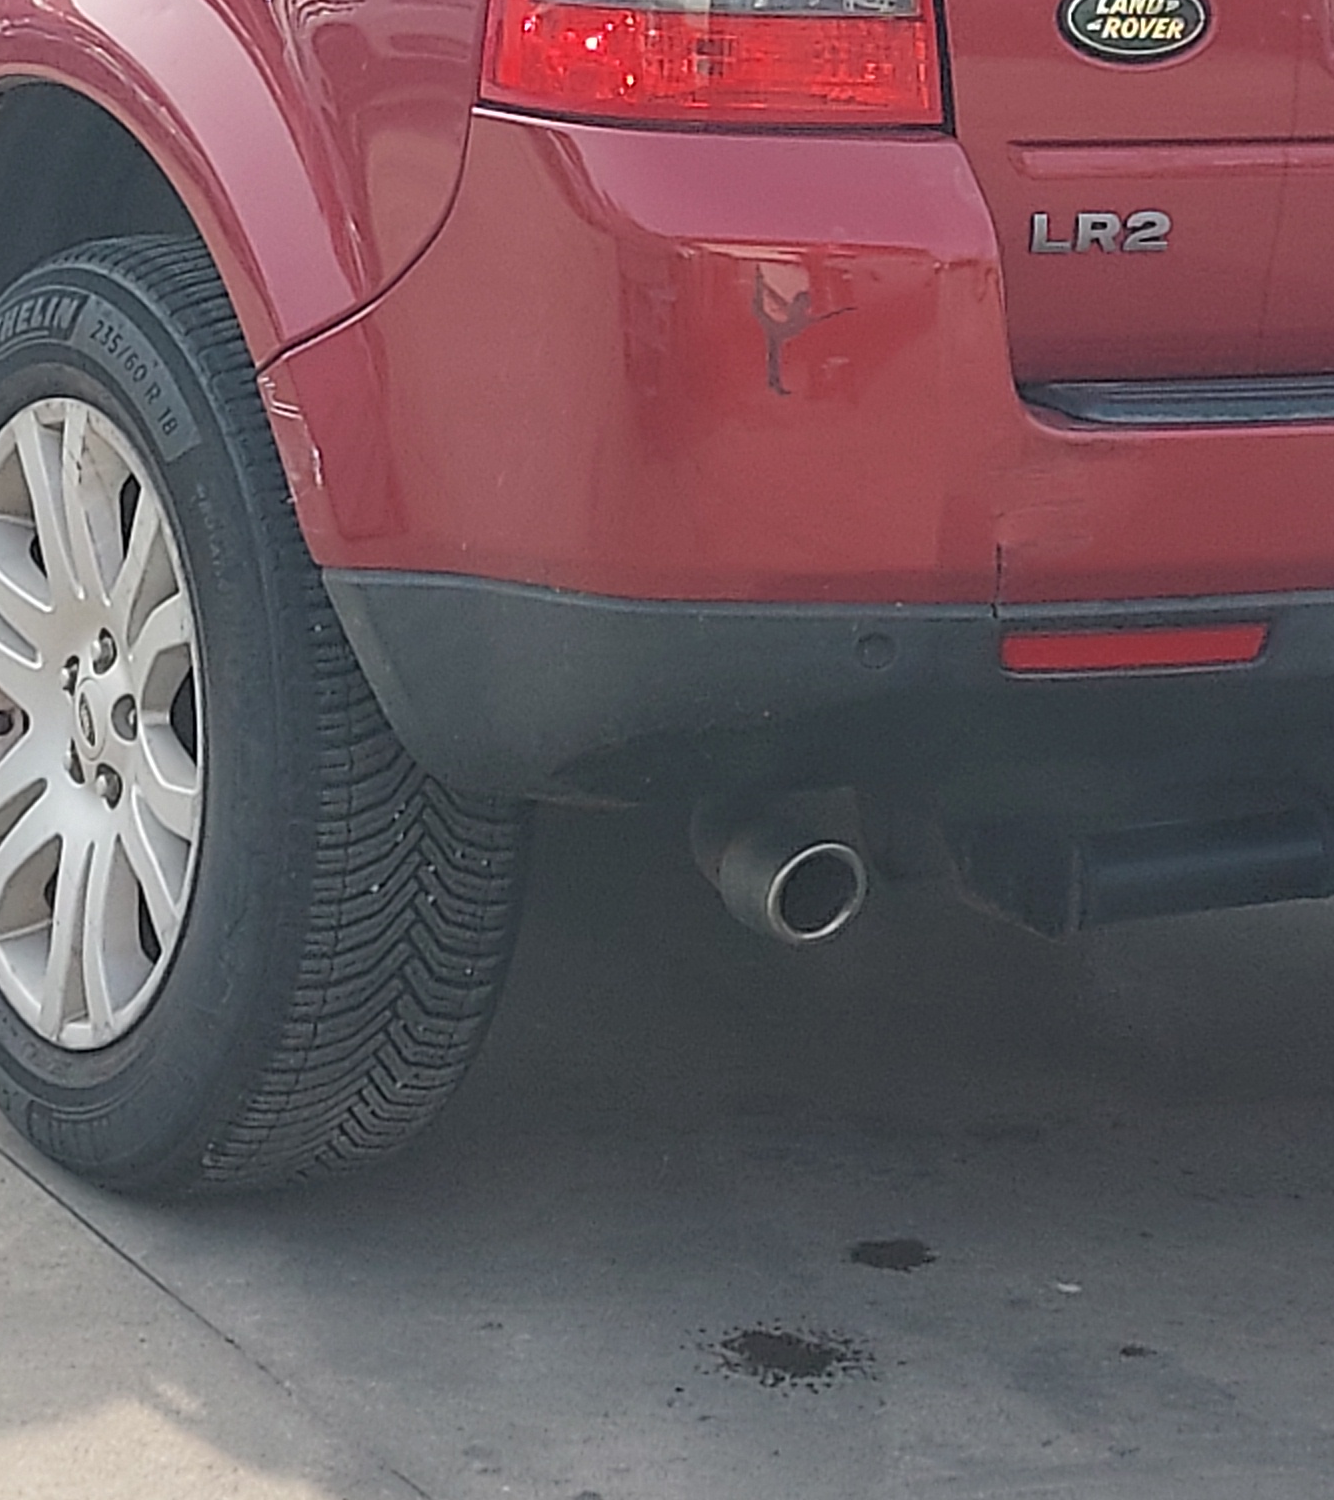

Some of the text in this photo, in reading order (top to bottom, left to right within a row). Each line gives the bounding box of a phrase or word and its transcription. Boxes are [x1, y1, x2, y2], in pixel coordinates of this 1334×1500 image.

[1100, 16, 1185, 40] ROVER
[1028, 210, 1172, 254] LR2
[88, 318, 151, 385] 235/60
[157, 408, 180, 437] 18
